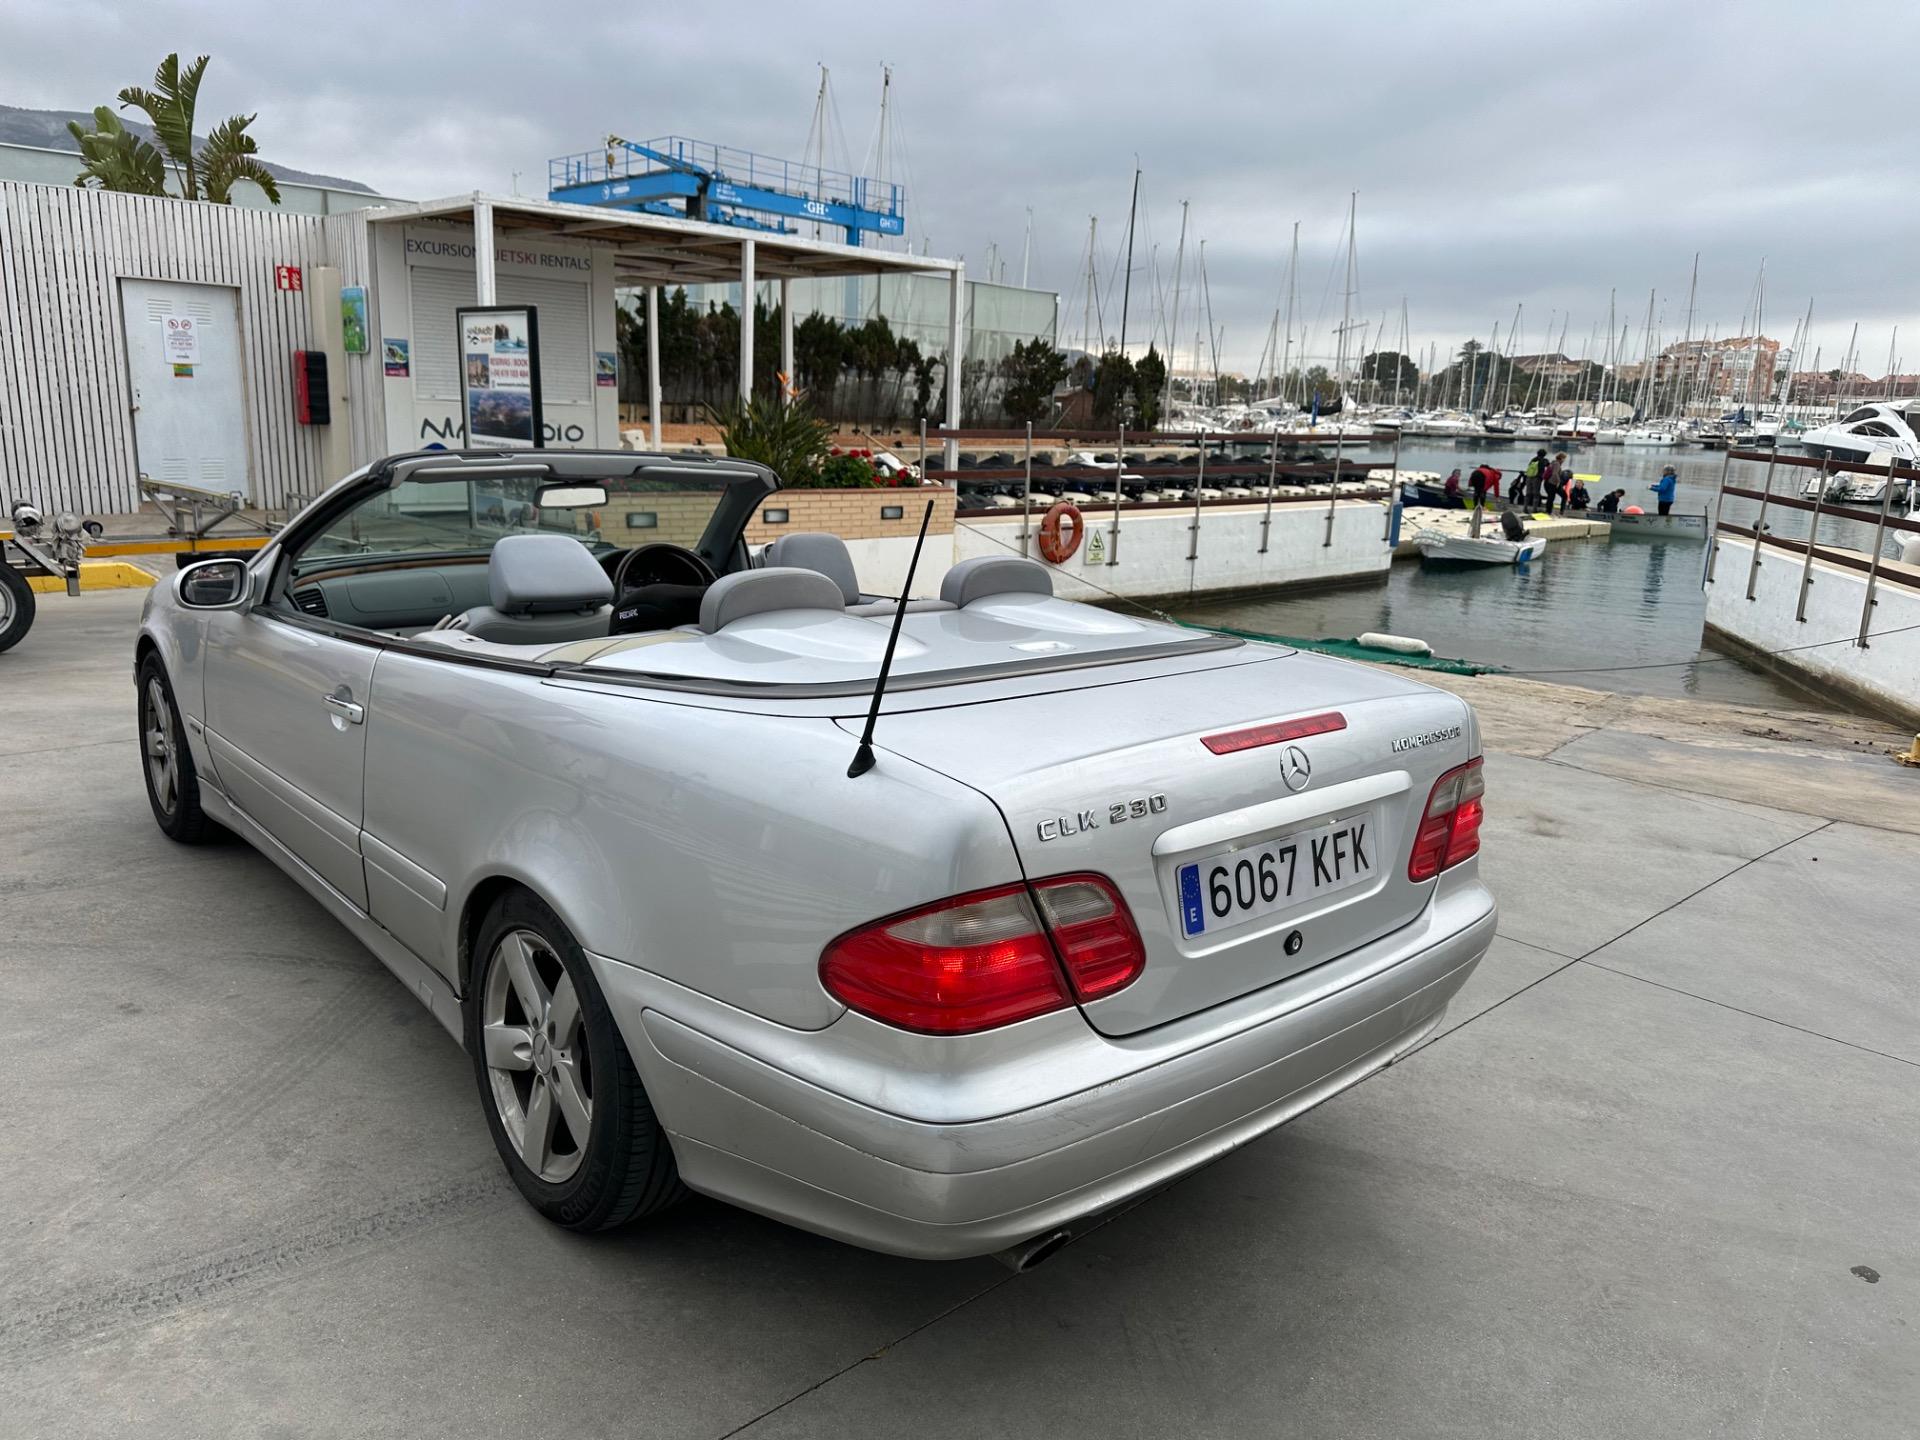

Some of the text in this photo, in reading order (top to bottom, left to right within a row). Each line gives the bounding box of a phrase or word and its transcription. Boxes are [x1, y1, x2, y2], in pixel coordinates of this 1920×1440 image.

[806, 201, 825, 215] GH
[494, 248, 537, 265] JETSKI
[540, 254, 591, 271] RENTALS
[1391, 726, 1461, 753] KOMPRESSOR
[1037, 792, 1169, 842] CLK 230
[1189, 822, 1371, 923] E 6067 KFK
